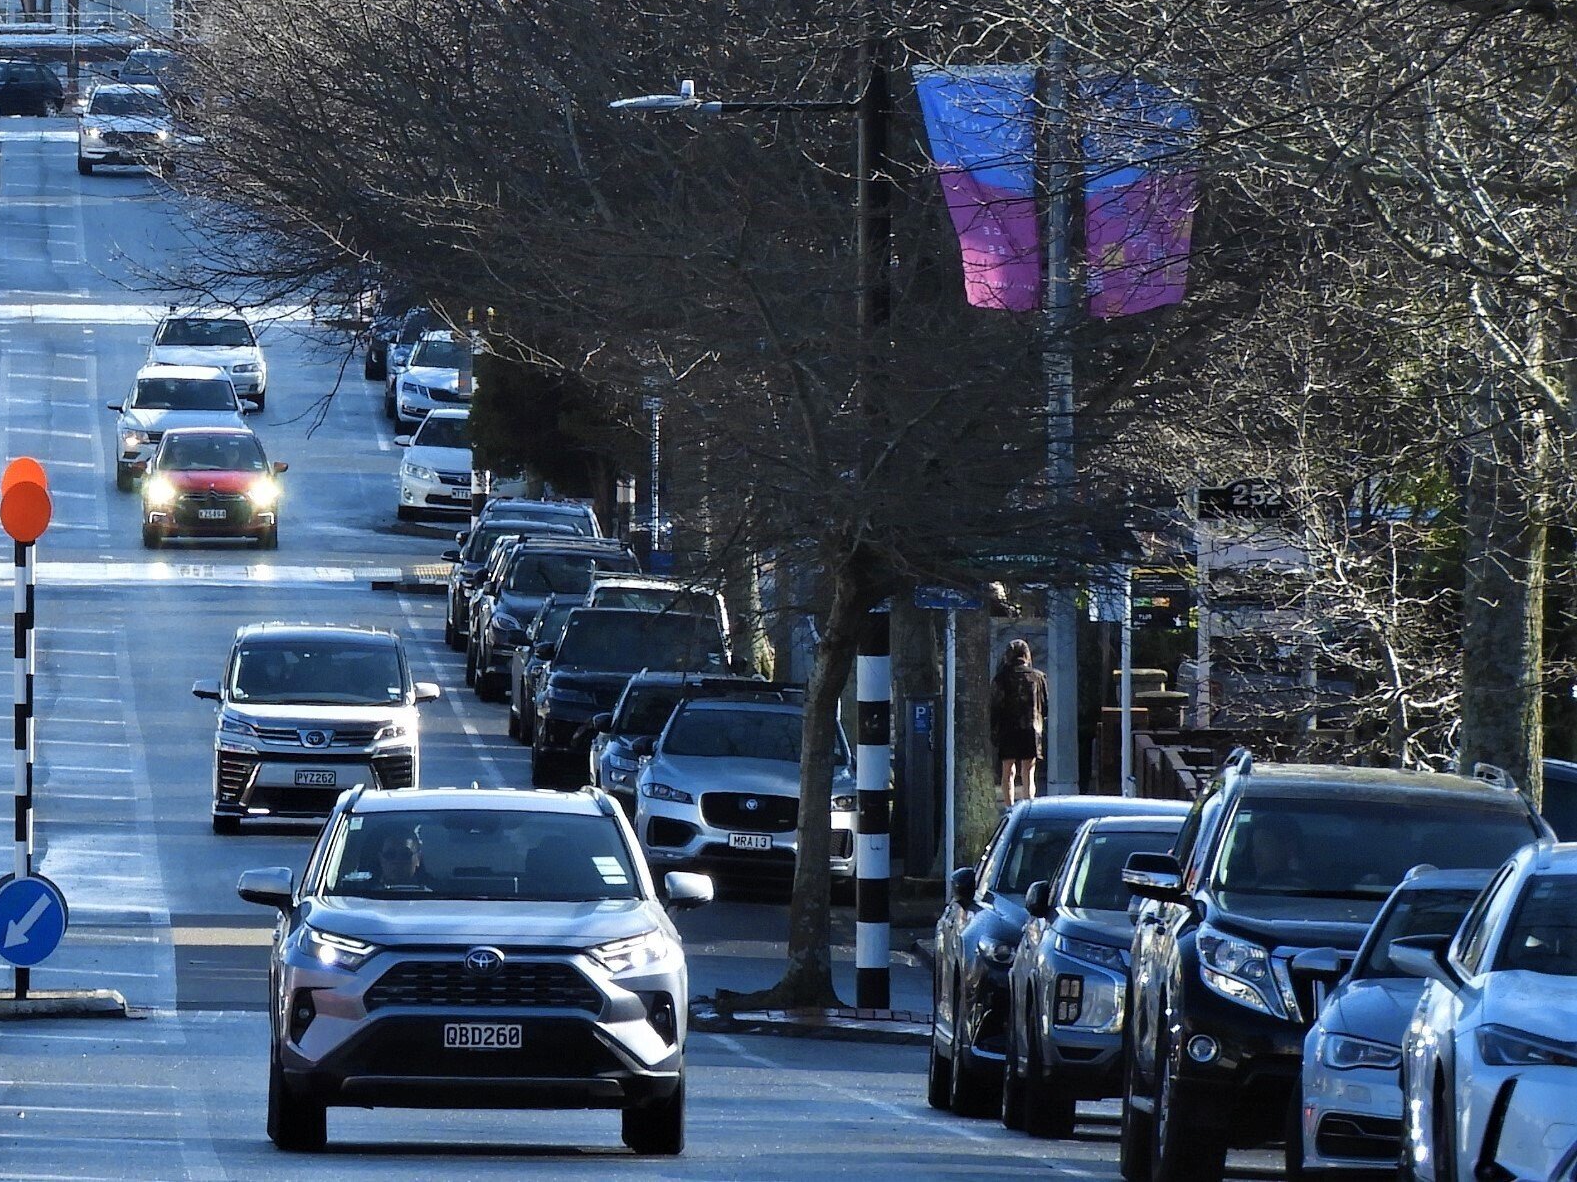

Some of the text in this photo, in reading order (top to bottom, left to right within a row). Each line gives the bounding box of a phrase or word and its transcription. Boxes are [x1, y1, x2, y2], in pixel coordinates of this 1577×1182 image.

[1232, 484, 1282, 505] 252
[297, 772, 334, 783] PYZ262
[446, 1026, 520, 1046] QBD260
